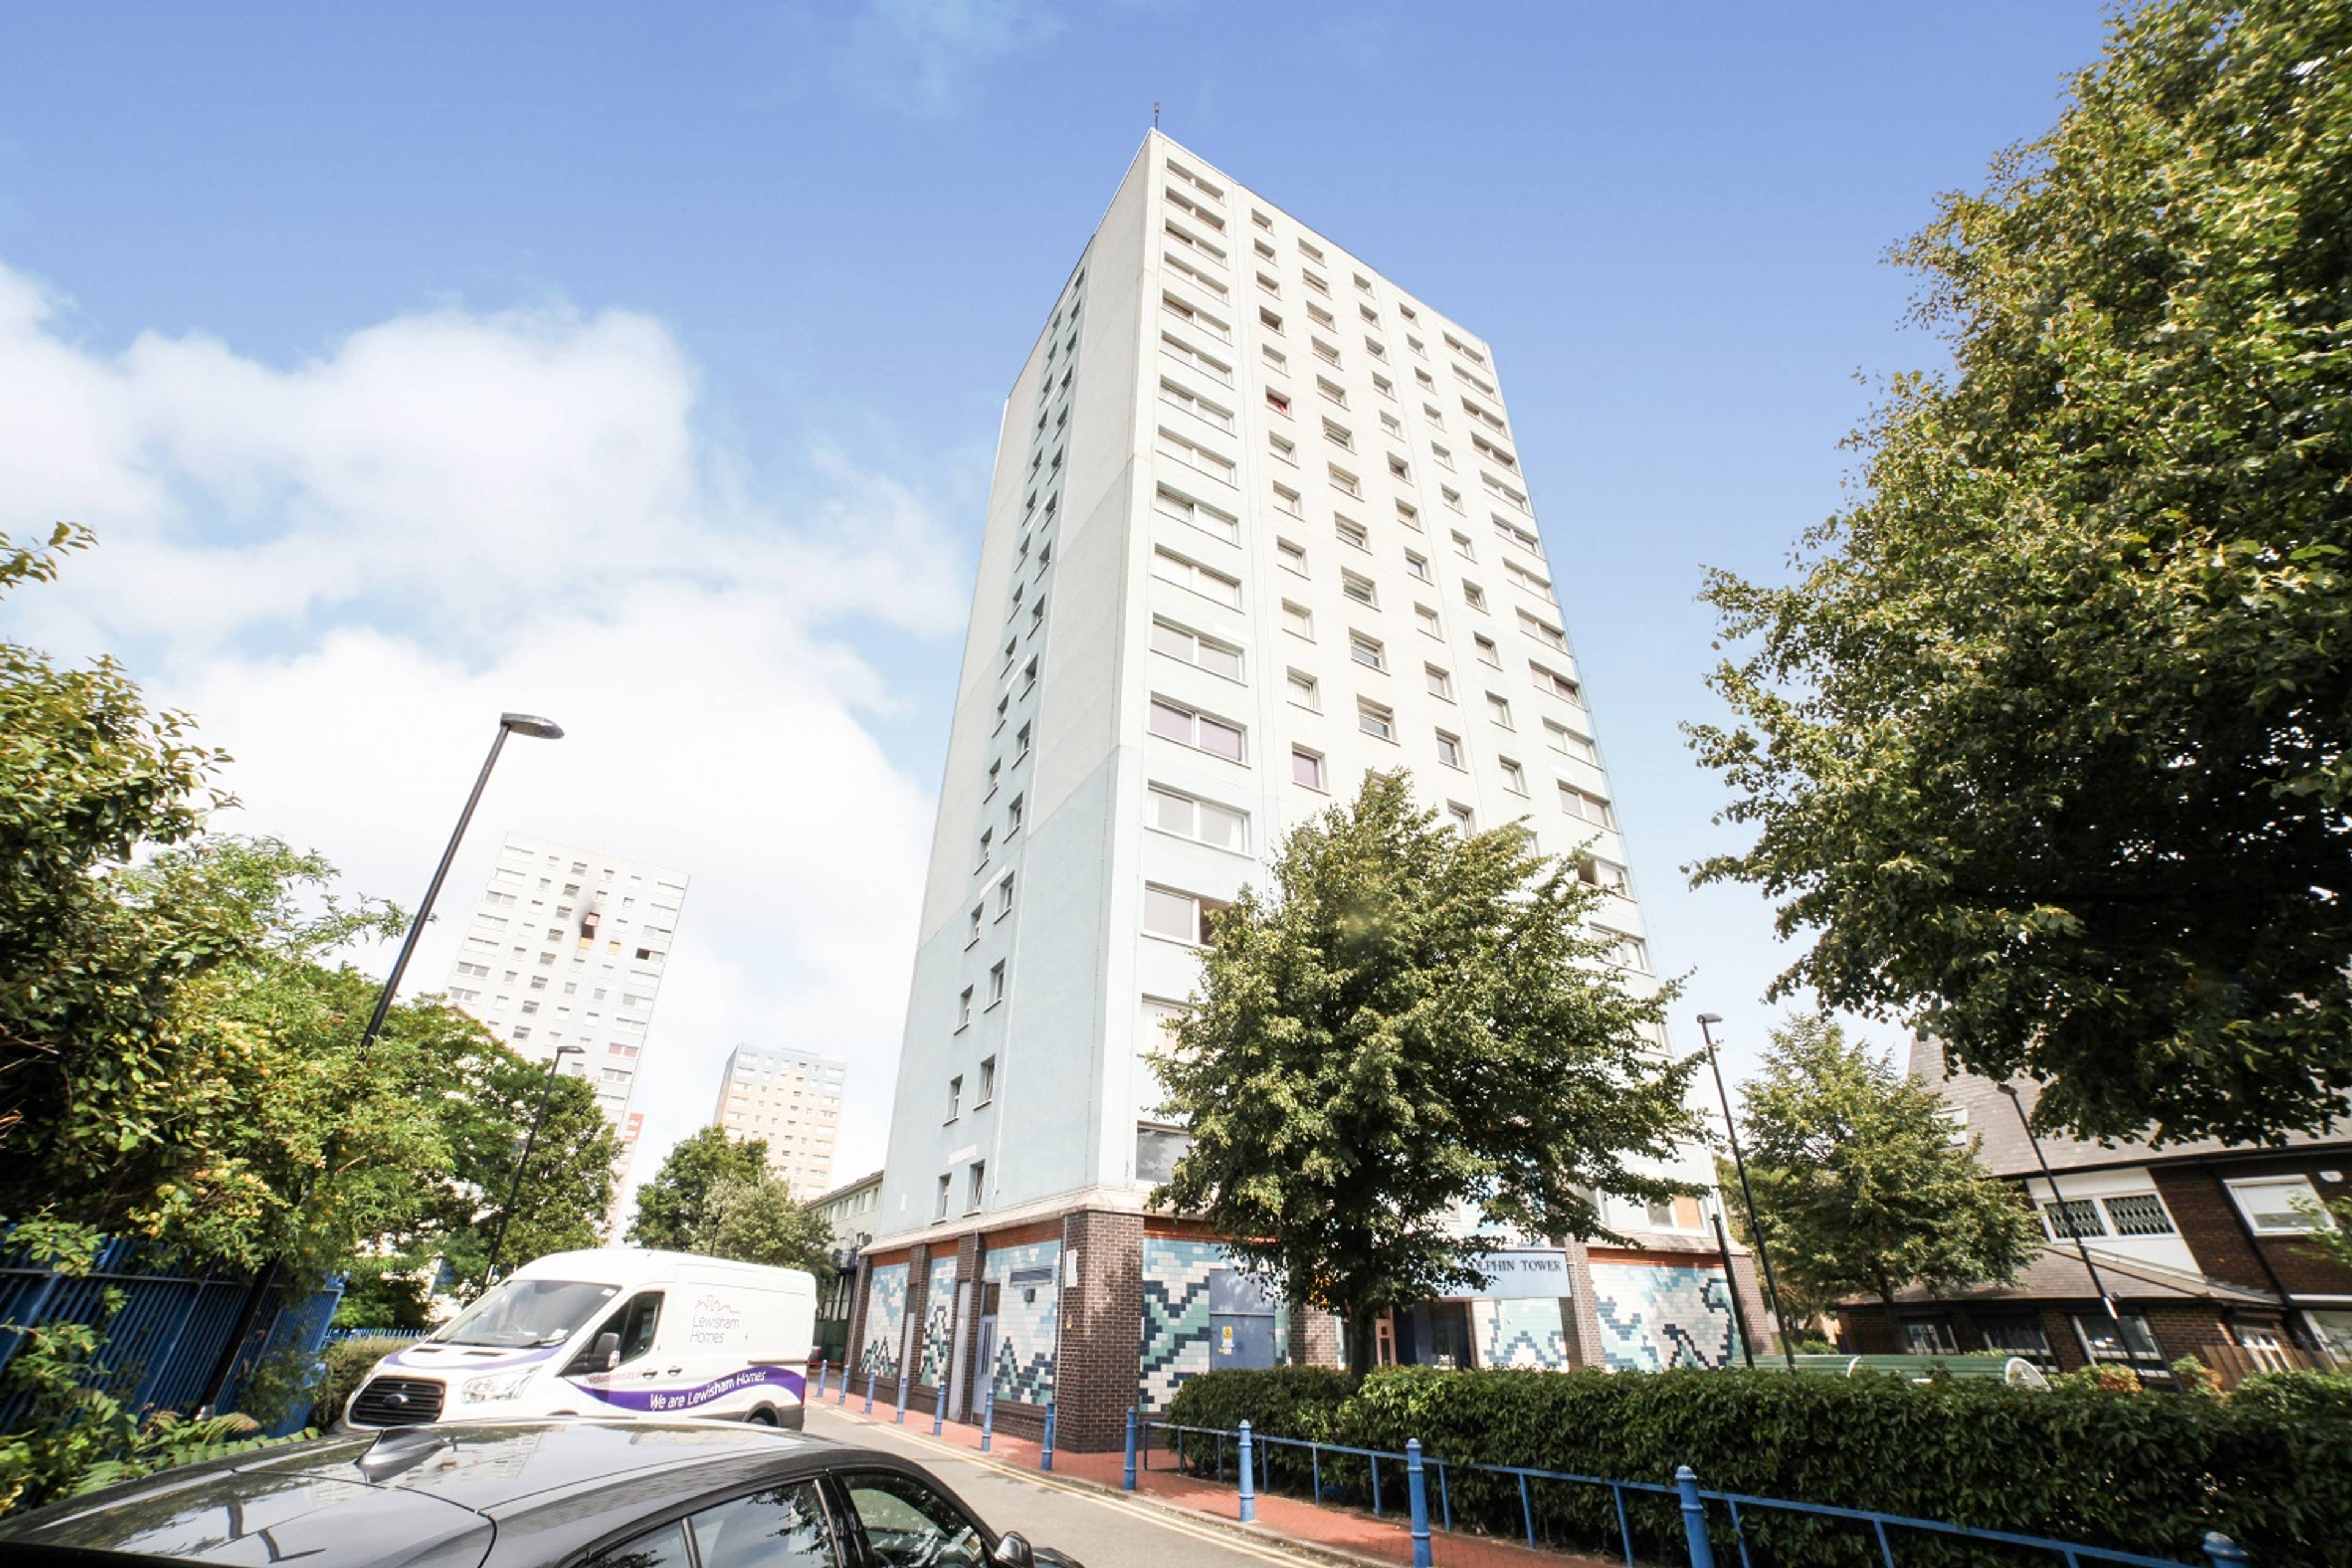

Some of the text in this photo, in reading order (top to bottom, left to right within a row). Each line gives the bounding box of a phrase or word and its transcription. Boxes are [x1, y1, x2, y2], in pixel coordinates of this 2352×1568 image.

[1520, 1260, 1561, 1272] TOWER
[693, 1314, 739, 1329] Lewisham
[690, 1329, 724, 1343] Homes
[650, 1371, 766, 1409] We are Lewisham Homes
